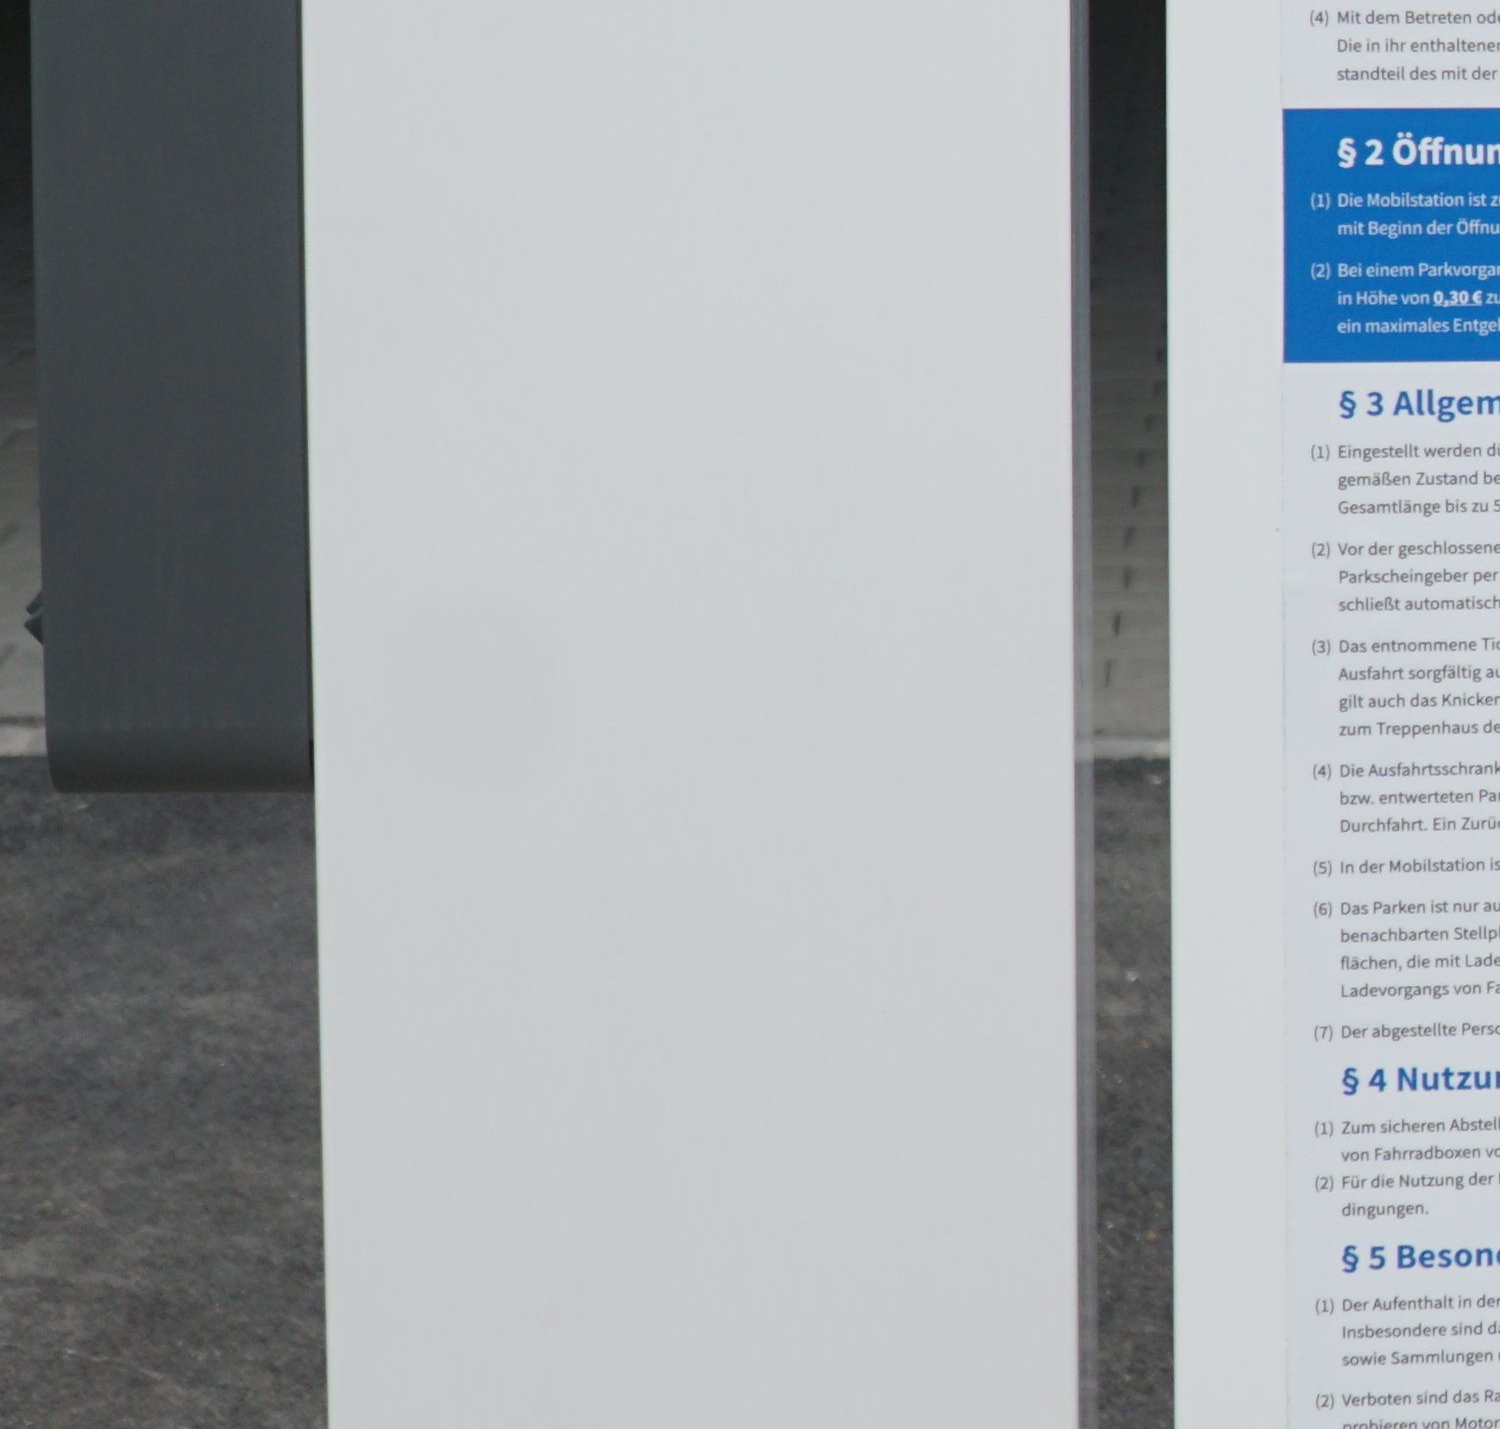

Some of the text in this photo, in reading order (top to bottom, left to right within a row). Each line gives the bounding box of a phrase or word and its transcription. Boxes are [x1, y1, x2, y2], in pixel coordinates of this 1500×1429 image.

[1337, 138, 1357, 170] §
[1364, 140, 1384, 167] 2
[1311, 193, 1331, 209] (1)
[1338, 193, 1364, 208] Die
[1367, 192, 1465, 207] Mobilstation
[1469, 194, 1487, 207] ist
[1337, 222, 1364, 236] mit
[1367, 221, 1422, 239] Beginn
[1426, 220, 1453, 235] der
[1311, 263, 1331, 280] (2)
[1338, 263, 1362, 278] Bei
[1366, 265, 1415, 277] einem
[1339, 391, 1357, 421] §
[1366, 392, 1384, 418] 3
[1311, 444, 1331, 462] (1)
[1338, 443, 1421, 463] Eingestellt
[1423, 443, 1482, 458] werden
[1337, 500, 1441, 517] Gesamtlänge
[1444, 498, 1467, 513] bis
[1471, 502, 1488, 513] zu
[1340, 817, 1428, 833] Durchfahrt.
[1433, 816, 1457, 831] Ein
[1313, 859, 1332, 877] (5)
[1340, 861, 1355, 874] In
[1358, 860, 1385, 874] der
[1389, 858, 1485, 873] Mobilstation
[1341, 1068, 1360, 1097] §
[1368, 1068, 1387, 1093] 4
[1340, 1150, 1369, 1162] von
[1374, 1145, 1481, 1161] Fahrradboxen
[1341, 1245, 1359, 1275] §
[1369, 1246, 1386, 1271] 5
[1342, 1352, 1387, 1367] sowie
[1390, 1349, 1493, 1367] Sammlungen
